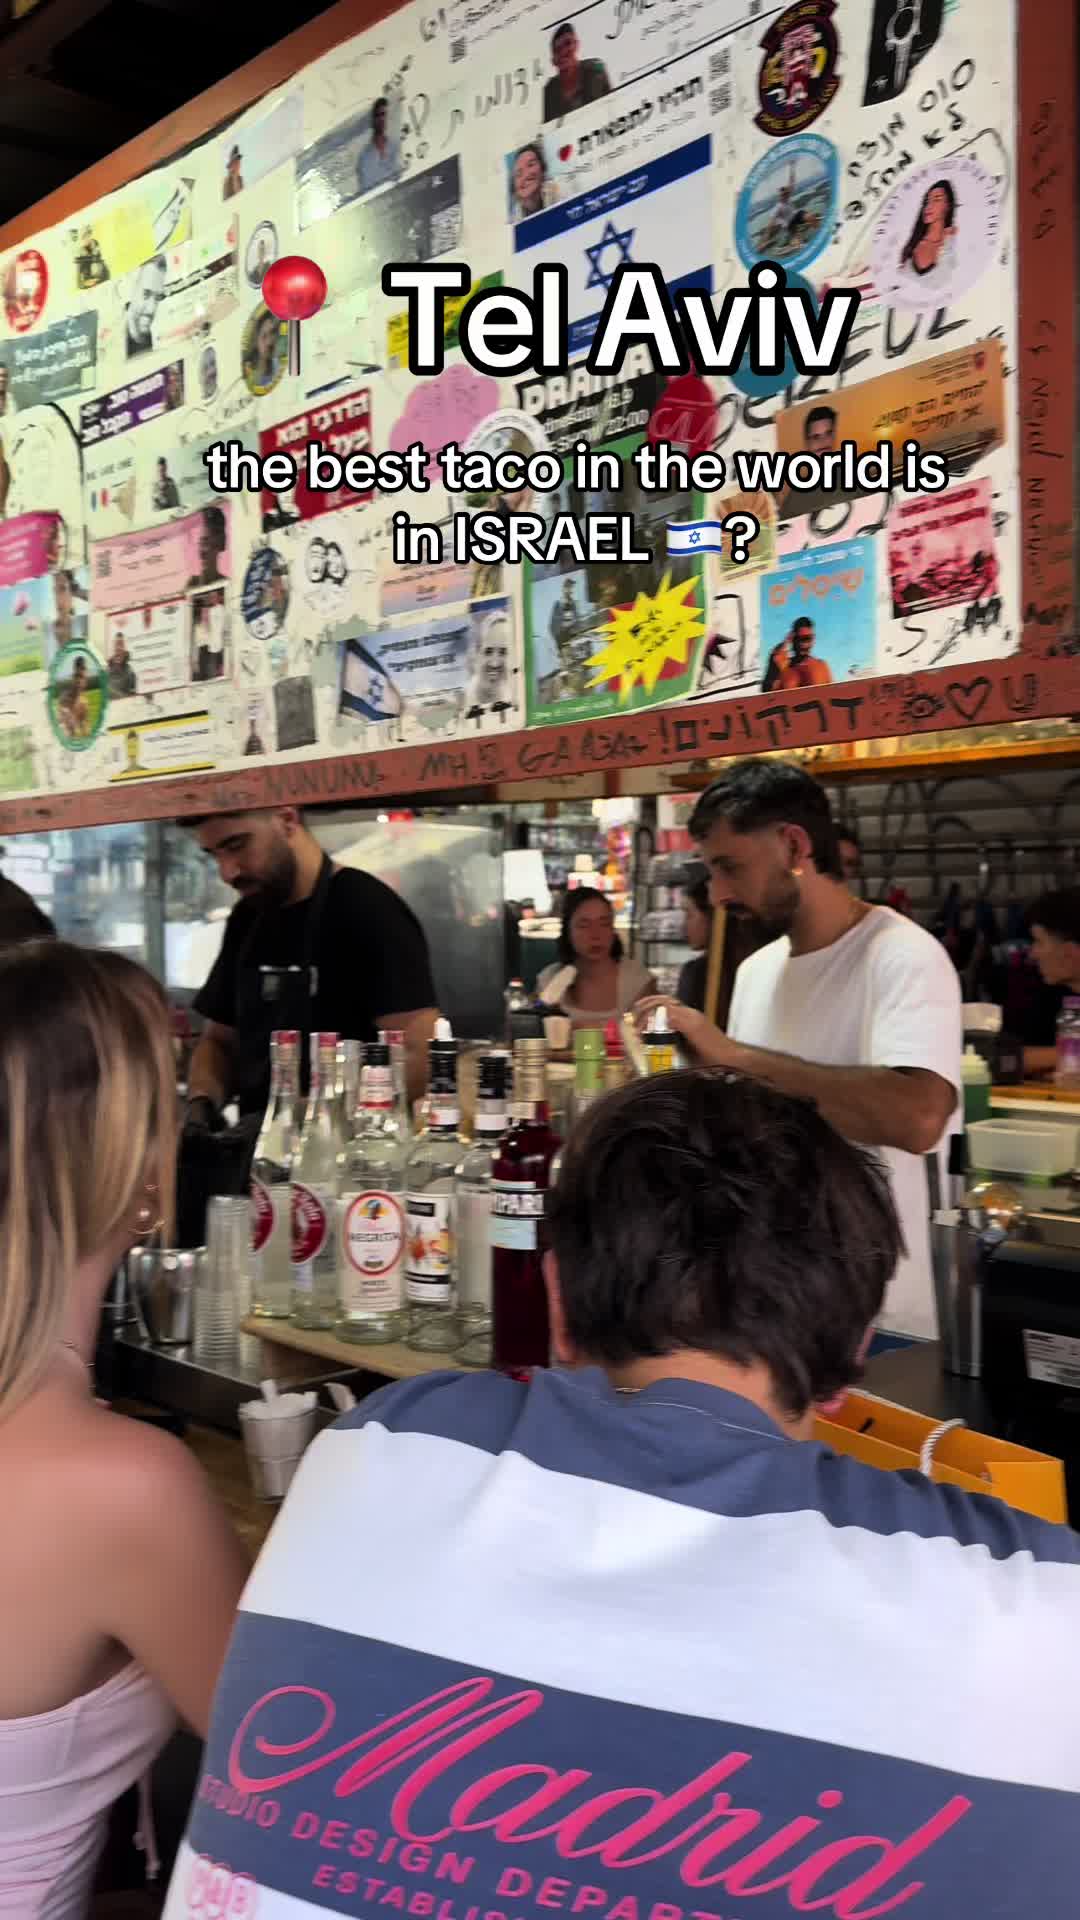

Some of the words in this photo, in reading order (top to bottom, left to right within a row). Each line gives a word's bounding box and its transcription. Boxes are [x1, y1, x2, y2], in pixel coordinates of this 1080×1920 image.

[228, 1675, 973, 1920] Madrid
[291, 1811, 476, 1884] DESIGN
[495, 1866, 742, 1920] DEPAR
[312, 1864, 525, 1920] ESTABLI
